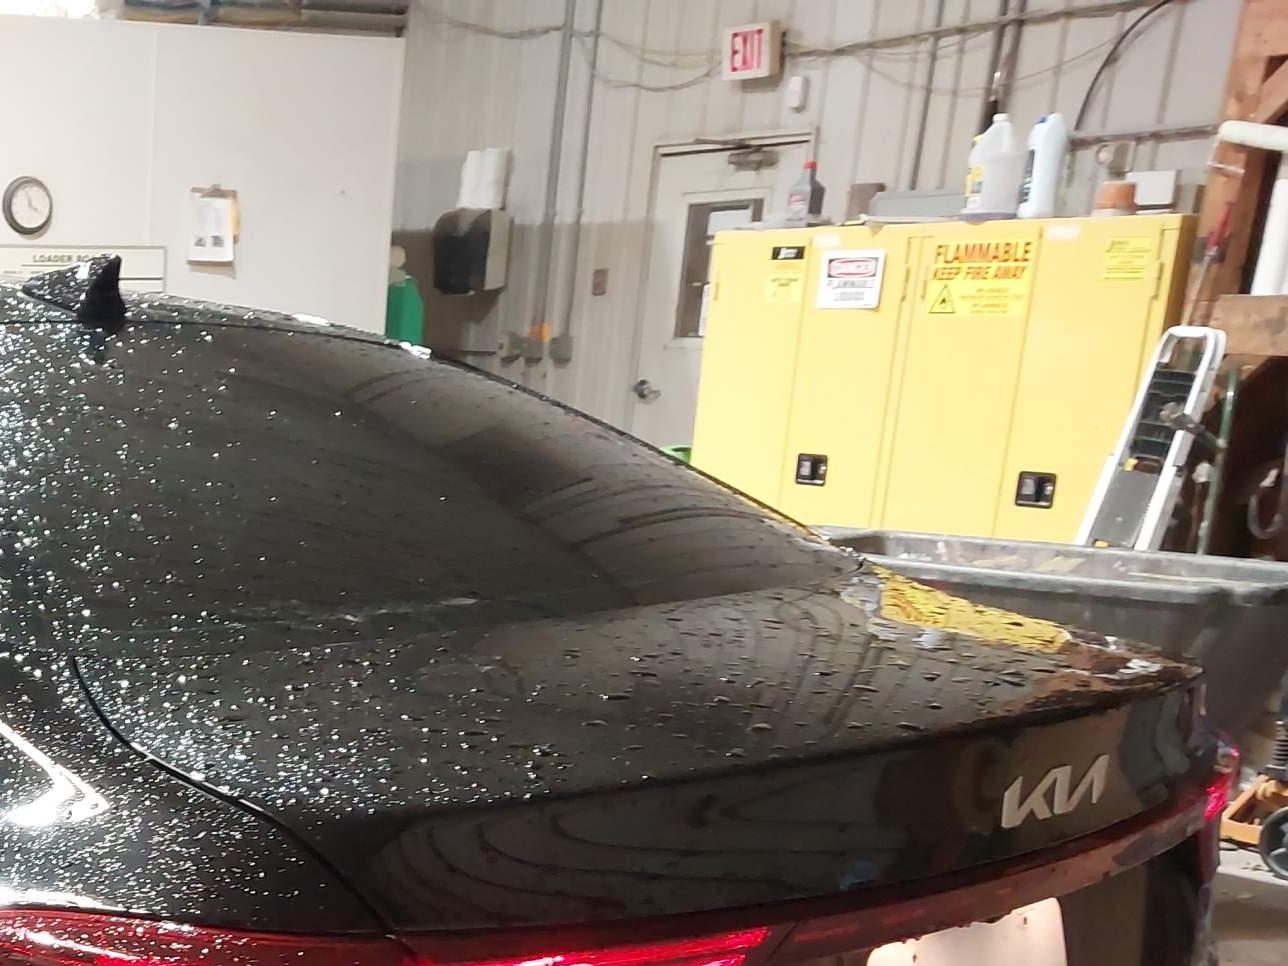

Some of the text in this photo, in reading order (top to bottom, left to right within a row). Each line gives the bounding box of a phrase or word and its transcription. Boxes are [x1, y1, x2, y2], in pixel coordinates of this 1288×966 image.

[730, 29, 764, 72] EXIT
[934, 241, 1033, 264] FLAMMABLE
[931, 267, 962, 280] KEEP
[963, 266, 992, 280] FIRE
[1001, 754, 1110, 829] KIA
